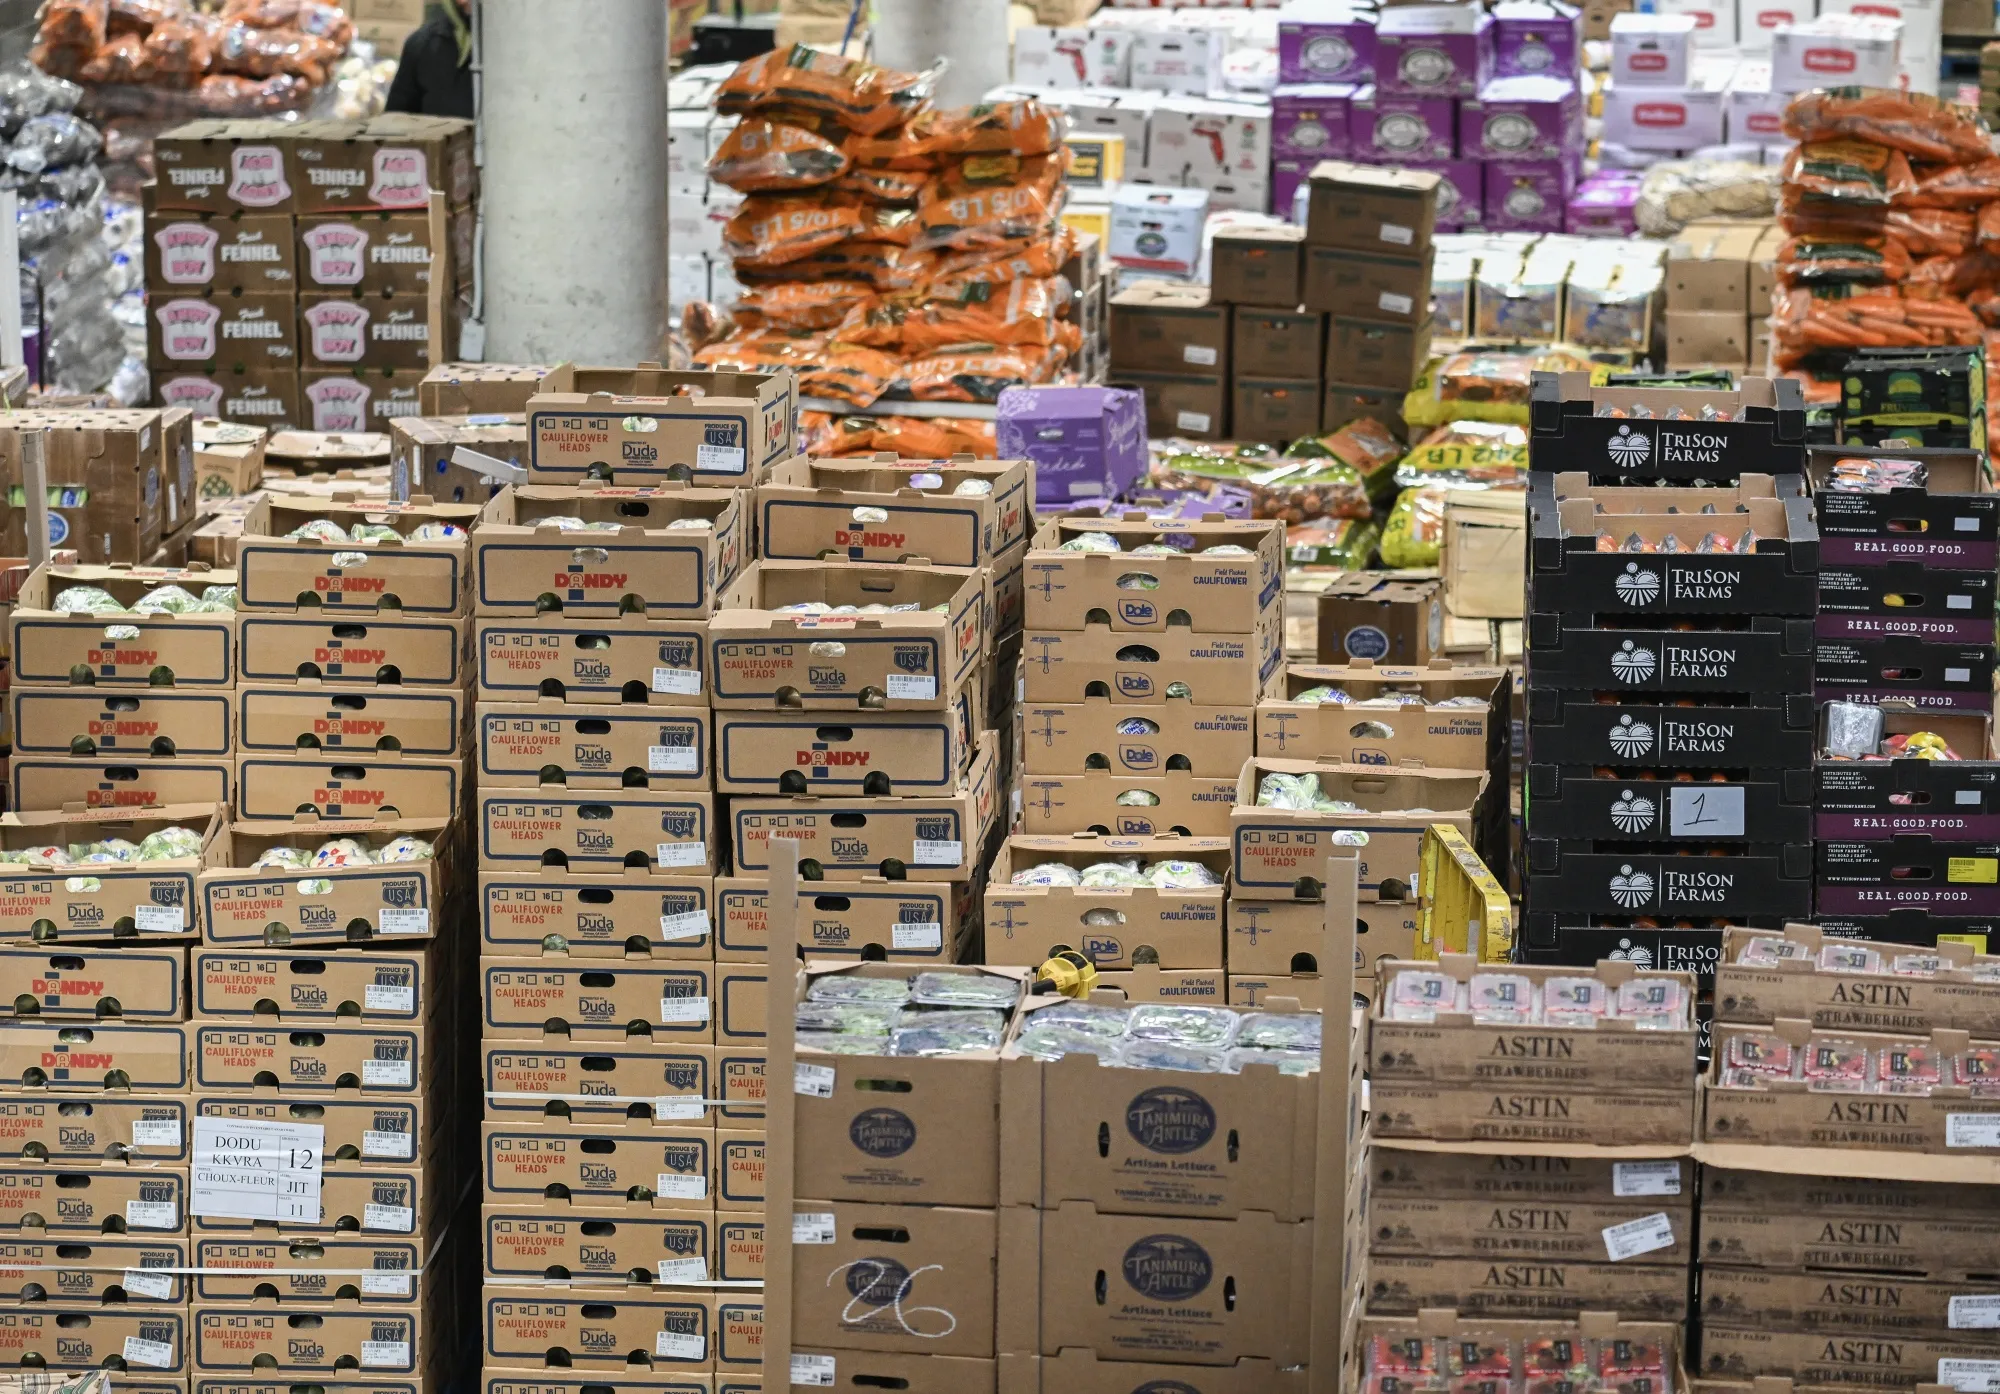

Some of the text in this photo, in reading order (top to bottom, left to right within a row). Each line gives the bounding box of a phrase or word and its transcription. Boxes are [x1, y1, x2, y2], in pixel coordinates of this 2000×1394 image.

[169, 169, 225, 184] FENNEL
[308, 169, 365, 186] FENNEL
[221, 245, 281, 261] FENNEL
[371, 247, 431, 262] FENNEL
[223, 322, 283, 338] FENNEL
[227, 401, 286, 415] FENNEL
[539, 420, 544, 428] 9
[562, 420, 571, 428] 12
[542, 433, 608, 442] CAULIFLOWER
[709, 432, 732, 444] USA
[559, 443, 591, 452] HEADS
[623, 443, 657, 458] Duda
[1665, 447, 1719, 462] FARMS
[836, 531, 904, 548] DANDY
[1855, 542, 1965, 554] REAL.GOOD.FOOD.
[315, 577, 385, 592] DANDY
[555, 574, 627, 588] DANDY
[1194, 577, 1247, 585] CAULIFLOWER
[1675, 583, 1732, 598] FARMS
[1126, 604, 1152, 615] Dole
[1848, 621, 1958, 633] REAL.GOOD.FOOD.
[488, 637, 547, 646] 9 12 16
[88, 651, 157, 664] DANDY
[315, 649, 385, 664] DANDY
[490, 650, 559, 660] CAULIFLOWER
[665, 650, 689, 661] USA
[1190, 650, 1244, 658] CAULIFLOWER
[508, 660, 541, 670] HEADS
[724, 660, 793, 669] CAULIFLOWER
[900, 655, 924, 667] USA
[574, 662, 610, 677] Duda
[742, 669, 775, 678] HEADS
[809, 670, 846, 682] Duda
[1670, 662, 1727, 677] FARMS
[1123, 677, 1149, 687] Dole
[89, 722, 158, 735] DANDY
[315, 720, 384, 735] DANDY
[1195, 722, 1247, 731] CAULIFLOWER
[1429, 727, 1482, 735] CAULIFLOWER
[1668, 737, 1724, 752] FARMS
[797, 751, 869, 765] DANDY
[1127, 749, 1153, 760] Dole
[87, 791, 156, 805] DANDY
[315, 790, 384, 805] DANDY
[1683, 793, 1718, 826] 1
[1854, 819, 1967, 828] REAL.GOOD.FOOD.
[1245, 847, 1315, 857] CAULIFLOWER
[1264, 858, 1296, 866] HEADS
[389, 889, 410, 901] USA
[1665, 887, 1724, 901] FARMS
[1858, 892, 1972, 900] REAL.GOOD.FOOD.
[214, 900, 283, 911] CAULIFLOWER
[233, 911, 266, 920] HEADS
[300, 908, 336, 920] Duda
[1161, 912, 1215, 920] CAULIFLOWER
[1091, 941, 1117, 952] Dole
[33, 980, 103, 996] DANDY
[1160, 987, 1215, 995] CAULIFLOWER
[1830, 983, 1912, 1006] ASTIN
[1816, 1010, 1924, 1027] STRAWBERRIES
[1492, 1036, 1573, 1057] ASTIN
[42, 1053, 112, 1068] DANDY
[1474, 1065, 1584, 1079] STRAWBERRIES
[1489, 1096, 1570, 1119] ASTIN
[1828, 1102, 1908, 1124] ASTIN
[1129, 1107, 1209, 1131] TANIMURA
[857, 1124, 912, 1140] TANIMURA
[1149, 1125, 1198, 1146] ANTLE
[1812, 1130, 1922, 1145] STRAWBERRIES
[216, 1136, 261, 1150] DODU
[495, 1141, 554, 1150] 9 12 16
[212, 1154, 262, 1167] KKVRA
[289, 1149, 313, 1169] 12
[497, 1154, 565, 1164] CAULIFLOWER
[670, 1154, 693, 1167] USA
[1125, 1158, 1216, 1171] Artisan Lettuce
[515, 1164, 547, 1173] HEADS
[580, 1166, 616, 1180] Duda
[287, 1182, 308, 1193] JIT
[146, 1190, 168, 1201] USA
[1488, 1209, 1571, 1231] ASTIN
[1820, 1223, 1900, 1244] ASTIN
[1472, 1239, 1583, 1252] STRAWBERRIES
[1483, 1266, 1565, 1287] ASTIN
[826, 1259, 956, 1337] 26
[1820, 1284, 1901, 1307] ASTIN
[205, 1330, 272, 1340] CAULIFLOWER
[222, 1340, 255, 1349] HEADS
[288, 1342, 324, 1355] Duda
